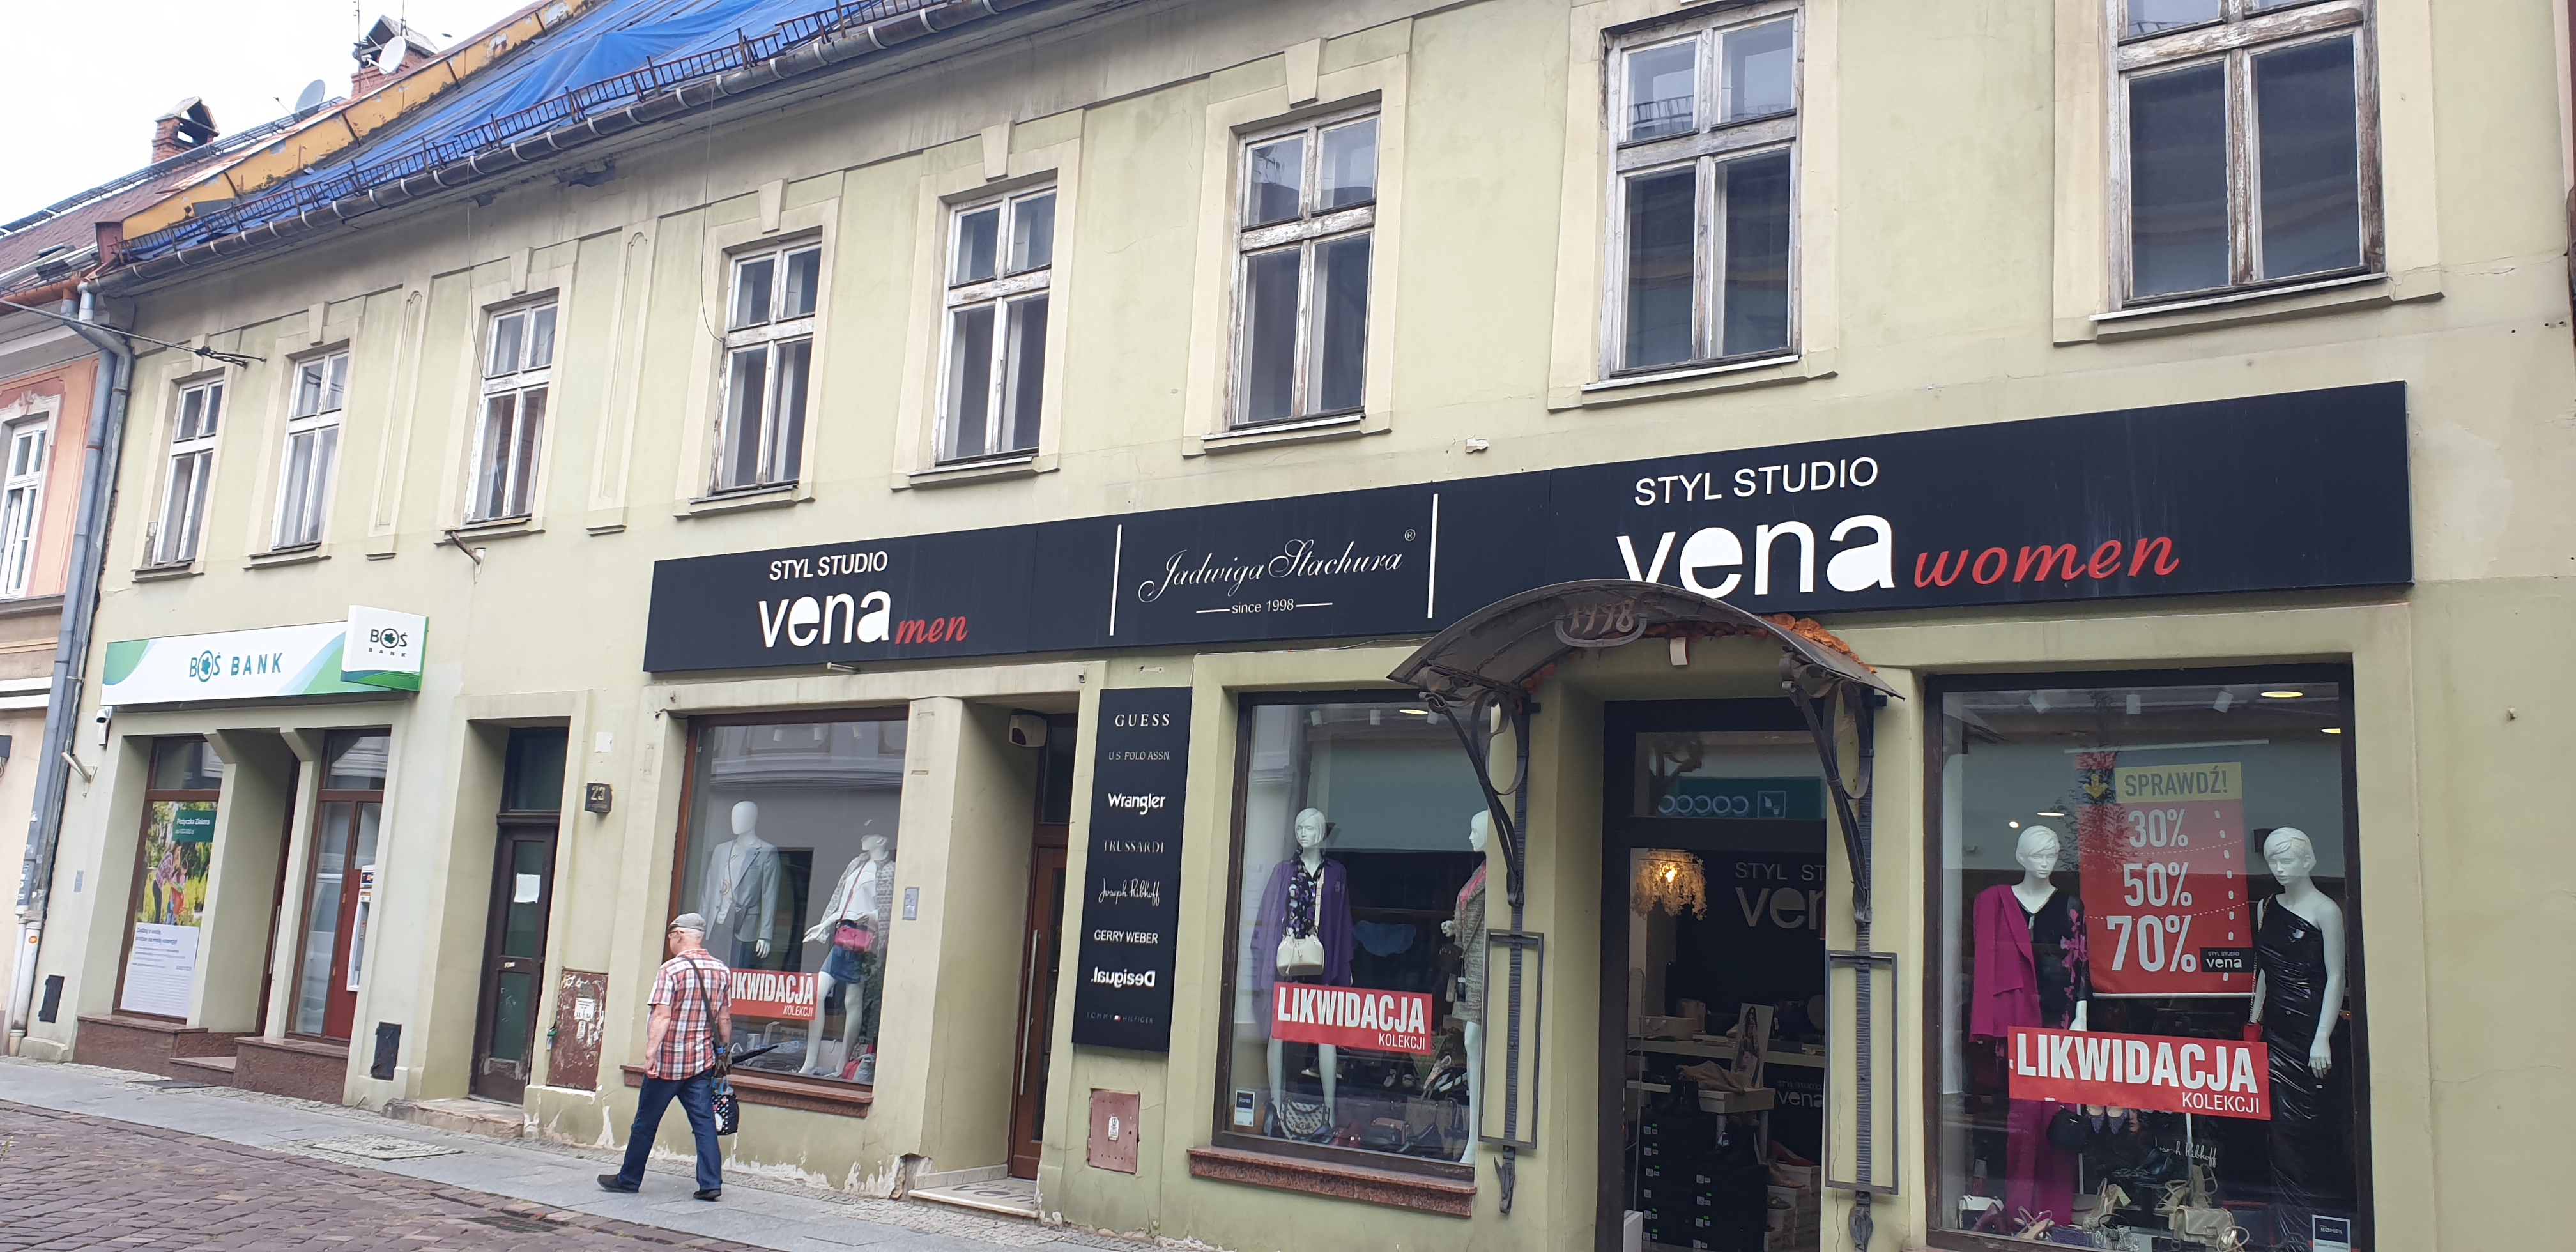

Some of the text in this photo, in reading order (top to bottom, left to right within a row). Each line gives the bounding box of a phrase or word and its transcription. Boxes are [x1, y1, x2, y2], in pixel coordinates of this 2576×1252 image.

[1634, 456, 1878, 507] STYL STUDIO
[769, 551, 888, 581] STYL STUDIO
[1616, 514, 2180, 599] vena women
[1138, 538, 1404, 603] Jadwiga Stachura
[1232, 598, 1294, 615] since 1998
[758, 590, 969, 648] vena men
[370, 628, 408, 648] BOŚ
[368, 647, 406, 657] BANK
[189, 650, 283, 682] BOŚ BANK
[1115, 713, 1170, 727] GUESS
[1124, 751, 1146, 760] POLO
[2124, 765, 2228, 797] SPRAWDŹ!
[591, 786, 606, 801] 23
[1108, 793, 1166, 815] Wrangler
[2128, 809, 2189, 848] 30%
[1103, 840, 1163, 853] TRUSSARDI
[1735, 862, 1788, 880] STYL
[1098, 878, 1128, 905] Joseph
[2123, 862, 2193, 907] 50%
[1094, 929, 1158, 944] GERRY WEBER
[2106, 914, 2197, 973] 70%
[2206, 958, 2242, 968] vena
[731, 972, 814, 1005] IKWIDACJA
[783, 1005, 813, 1018] KOLEKCJI
[1087, 1011, 1153, 1024] TOMMY HILFIGER
[1277, 986, 1425, 1034] LIKWIDACJA
[1378, 1032, 1425, 1050] KOLEKCJI
[2016, 1032, 2259, 1094] LIKWIDACJA
[1777, 1090, 1823, 1108] vena
[2181, 1092, 2260, 1114] KOLEKCJI
